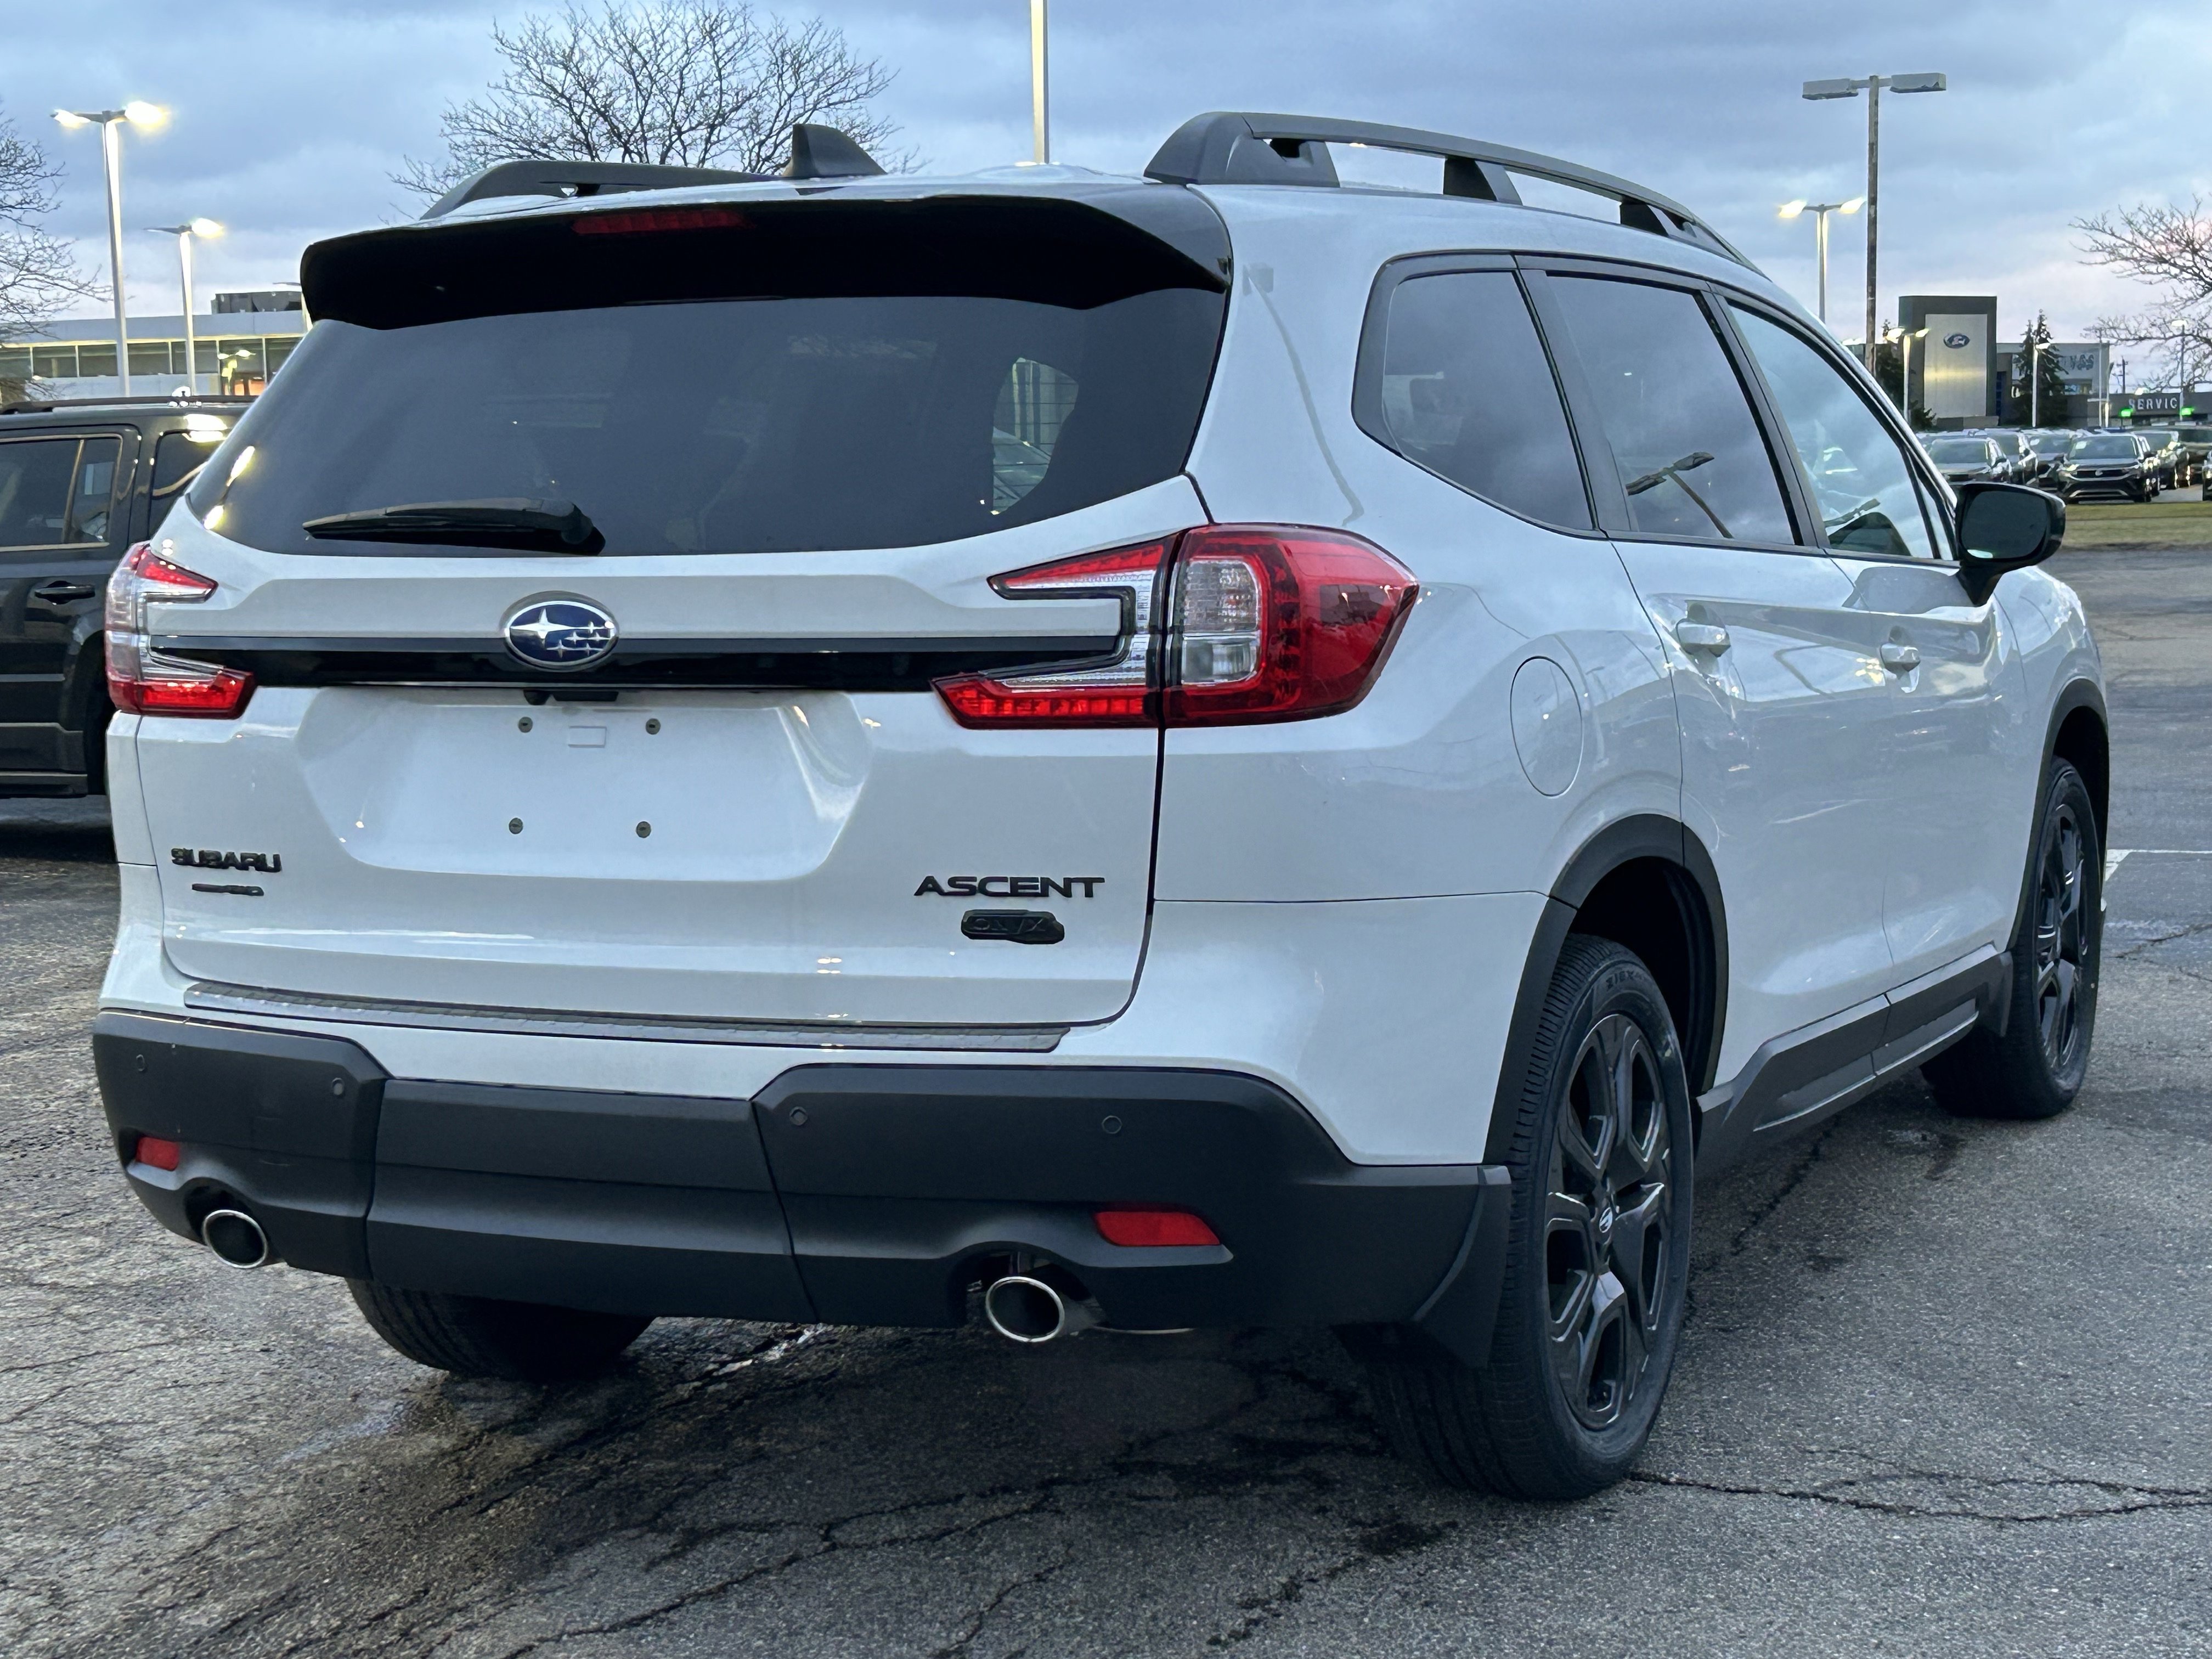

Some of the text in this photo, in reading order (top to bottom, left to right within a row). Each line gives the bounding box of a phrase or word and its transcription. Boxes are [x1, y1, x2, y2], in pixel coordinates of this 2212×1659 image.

[2128, 397, 2181, 410] SERVIC
[171, 848, 281, 872] SUBARU
[914, 876, 1105, 898] ASCENT
